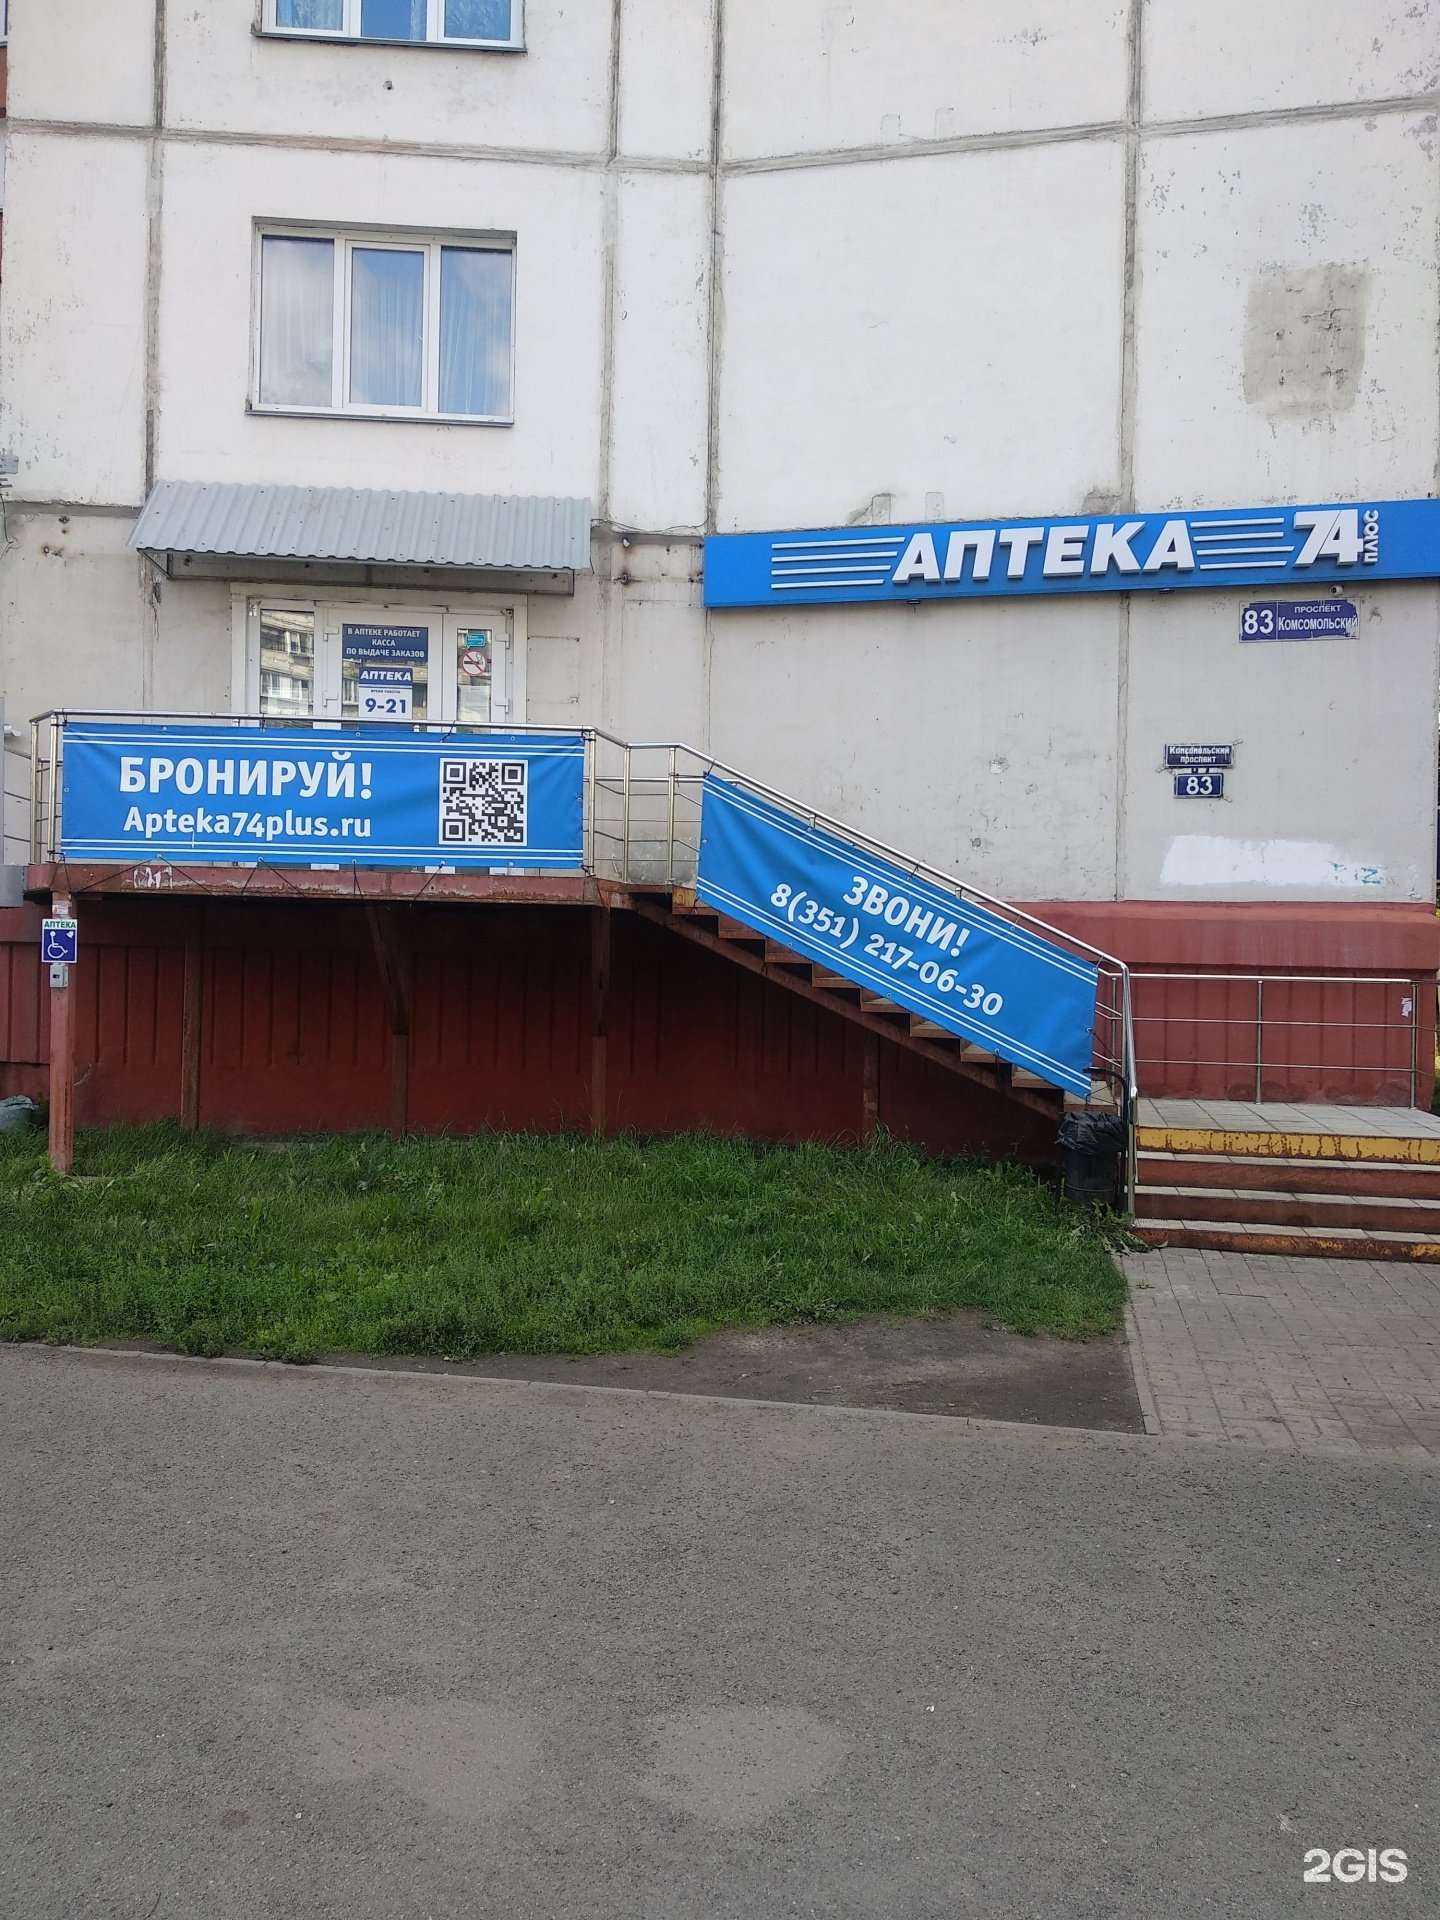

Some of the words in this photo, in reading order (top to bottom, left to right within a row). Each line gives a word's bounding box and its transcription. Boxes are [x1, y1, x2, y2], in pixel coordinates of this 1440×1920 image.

[891, 519, 1196, 584] АПТЕКА
[1292, 508, 1364, 566] 74
[1363, 509, 1380, 564] ПЛЮС
[1294, 604, 1342, 614] ПРОСПЕКТ
[1243, 608, 1275, 635] 83
[347, 627, 353, 635] В
[354, 627, 382, 636] АПТЕКЕ
[383, 629, 421, 638] РАБОТАЕТ
[346, 647, 357, 655] ПО
[358, 648, 390, 657] ВЫДАЧЕ
[391, 649, 425, 658] ЗАКАЗОВ
[371, 639, 396, 647] КАССА
[360, 670, 412, 681] АПТЕКА
[365, 697, 407, 714] 9-21
[119, 751, 373, 800] БРОНИРУЙ!
[1186, 776, 1213, 795] 83
[123, 806, 372, 842] Apteka74plus.ru
[43, 920, 77, 929] АПТЕКА
[843, 876, 970, 958] ЗВОНИ!
[770, 883, 860, 949] 8(351)
[863, 933, 1004, 1016] 217-06-30
